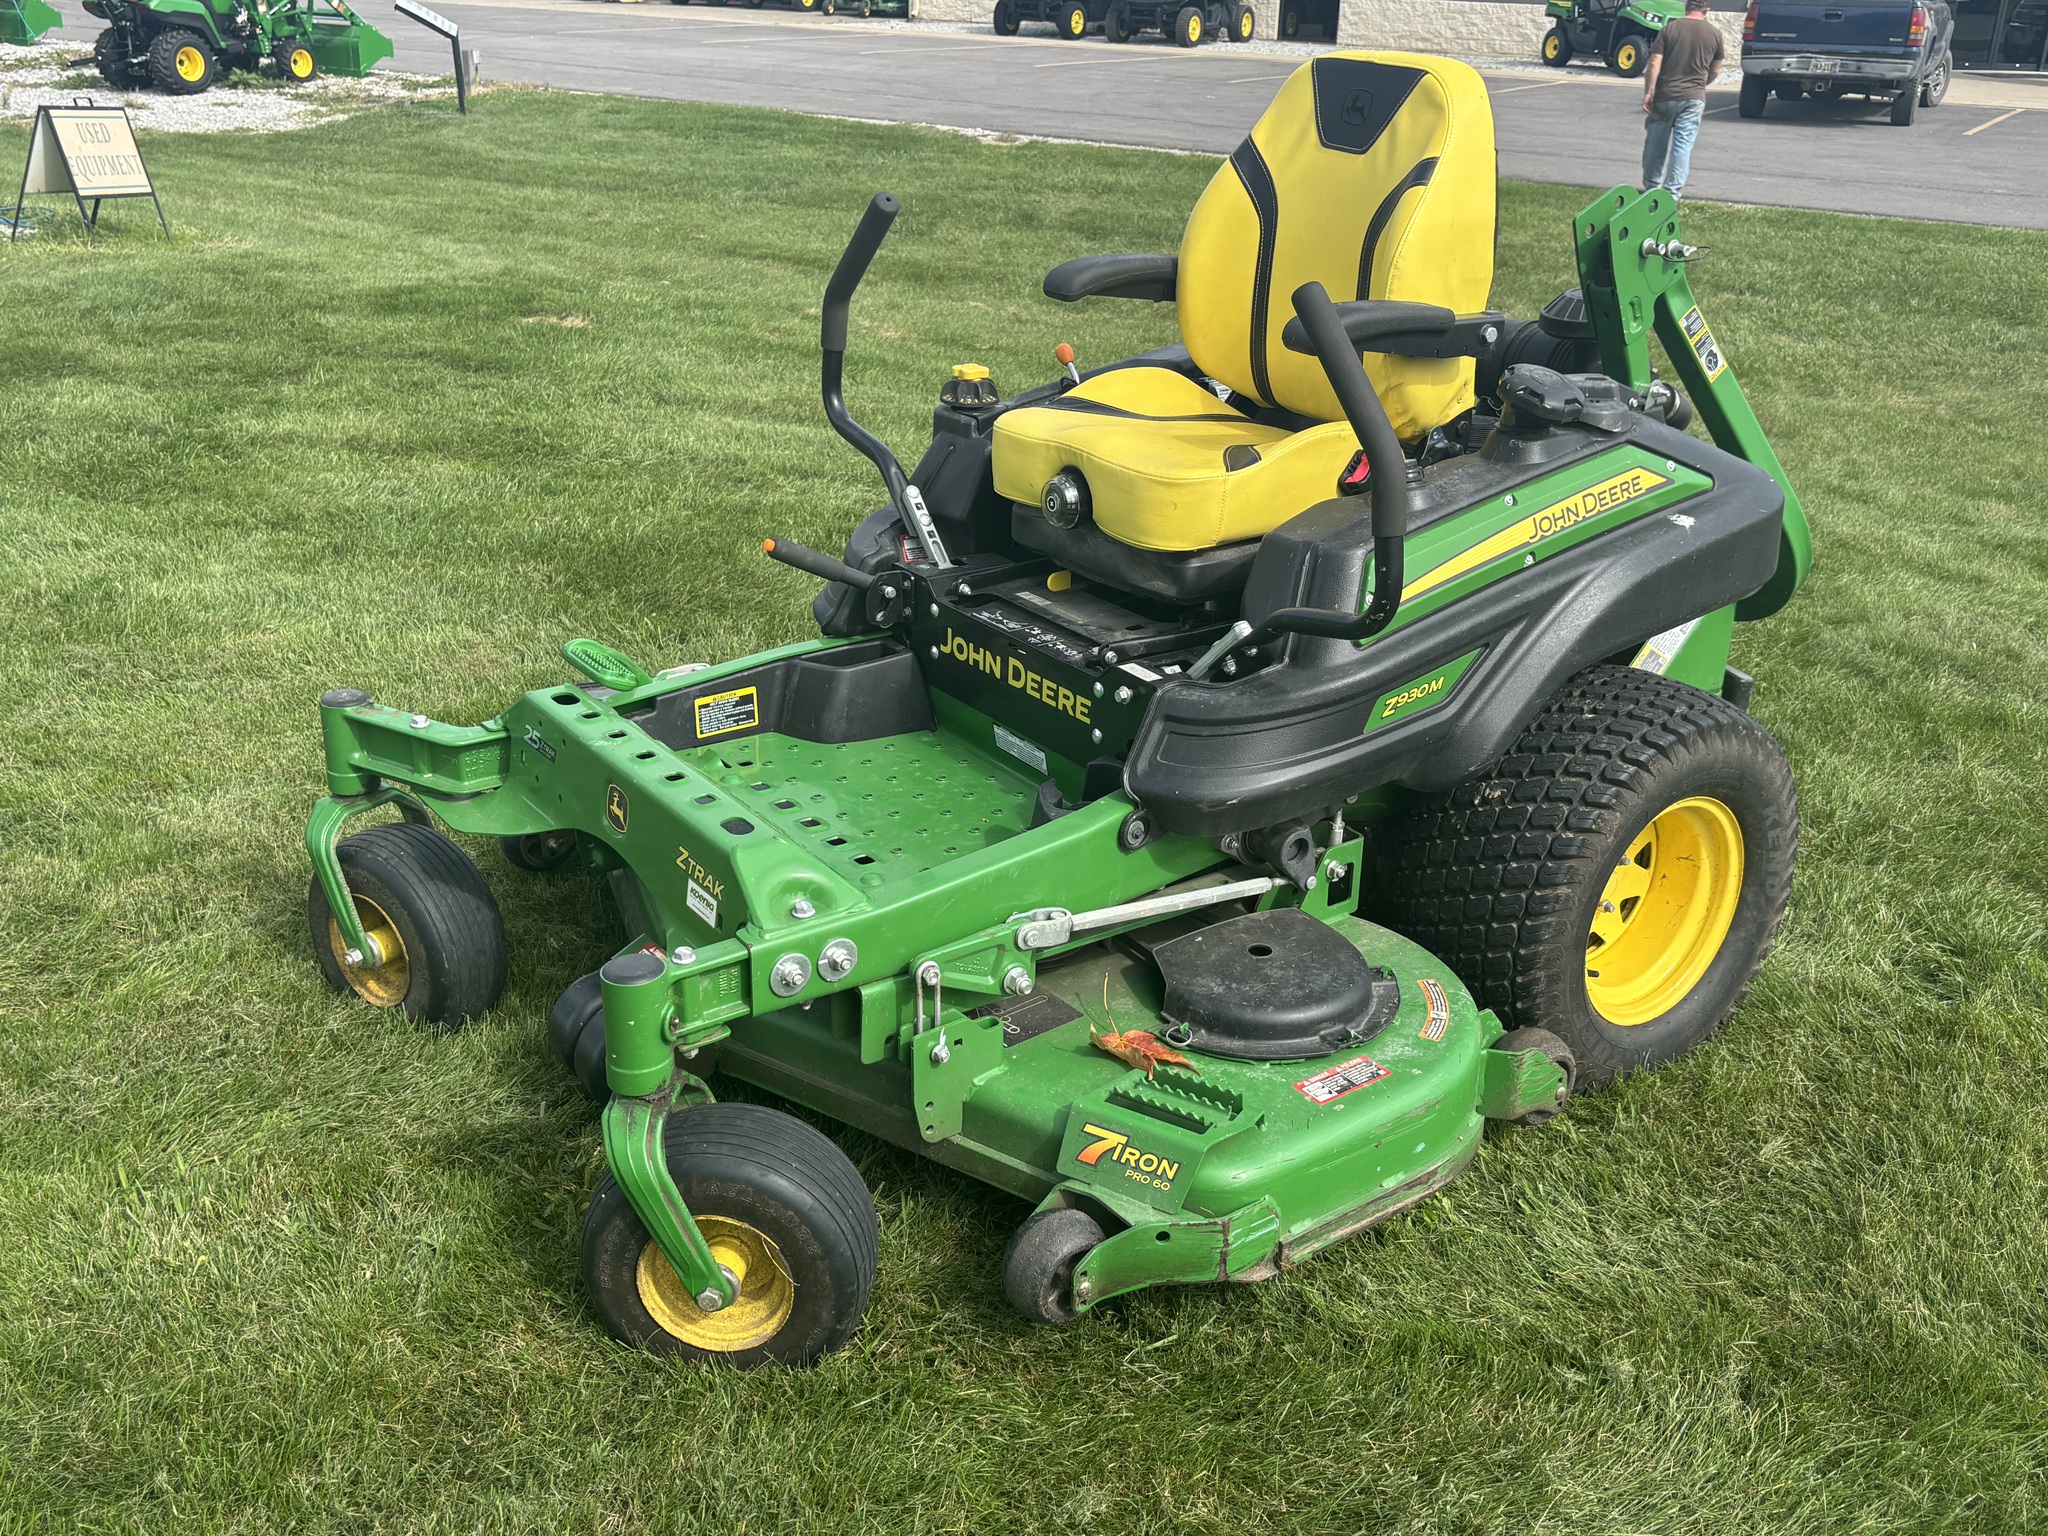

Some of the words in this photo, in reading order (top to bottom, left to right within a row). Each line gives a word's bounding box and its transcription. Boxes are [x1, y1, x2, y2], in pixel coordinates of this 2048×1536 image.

[75, 122, 111, 144] USED
[67, 154, 142, 183] EQUIPMENT
[1529, 501, 1580, 540] JOHN
[1582, 475, 1643, 515] DEERE
[940, 627, 1002, 680] JOHN
[1008, 656, 1092, 725] DEERE
[1381, 675, 1446, 719] Z930M
[523, 723, 541, 750] 25
[675, 844, 726, 902] ZTRAK
[1124, 1169, 1151, 1185] PRO
[1152, 1179, 1172, 1192] 60
